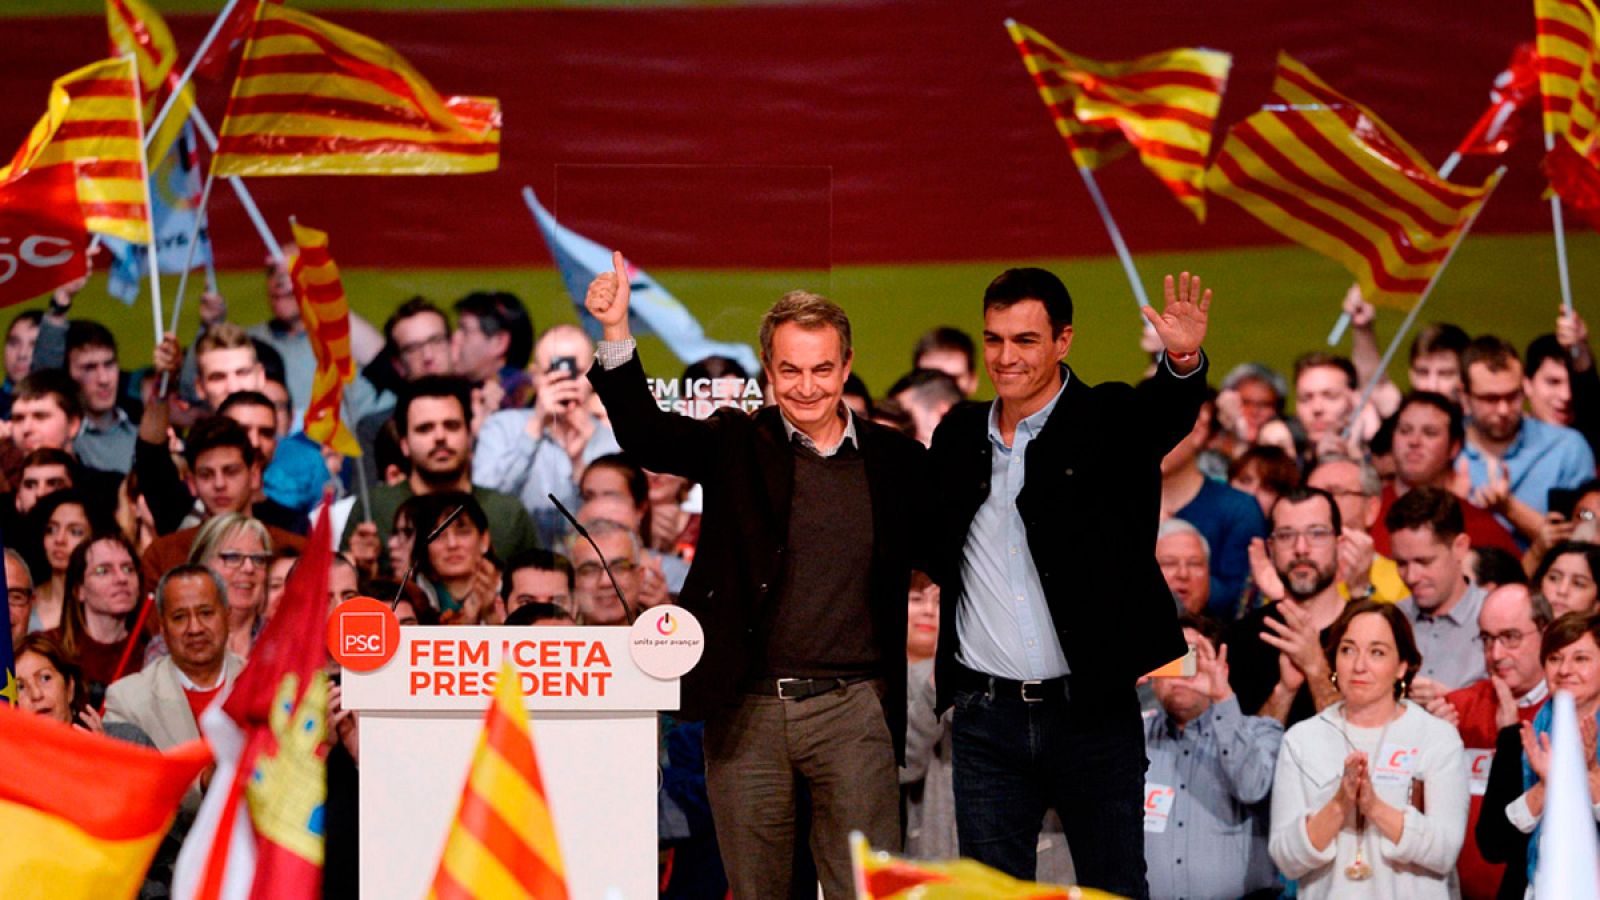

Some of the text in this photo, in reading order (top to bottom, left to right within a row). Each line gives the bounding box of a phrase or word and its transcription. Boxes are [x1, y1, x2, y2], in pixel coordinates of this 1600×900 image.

[685, 377, 763, 398] ICETA
[345, 634, 380, 651] PSC
[634, 637, 699, 647] units per avançar
[410, 640, 489, 666] FEM
[410, 671, 612, 696] PRESDENT
